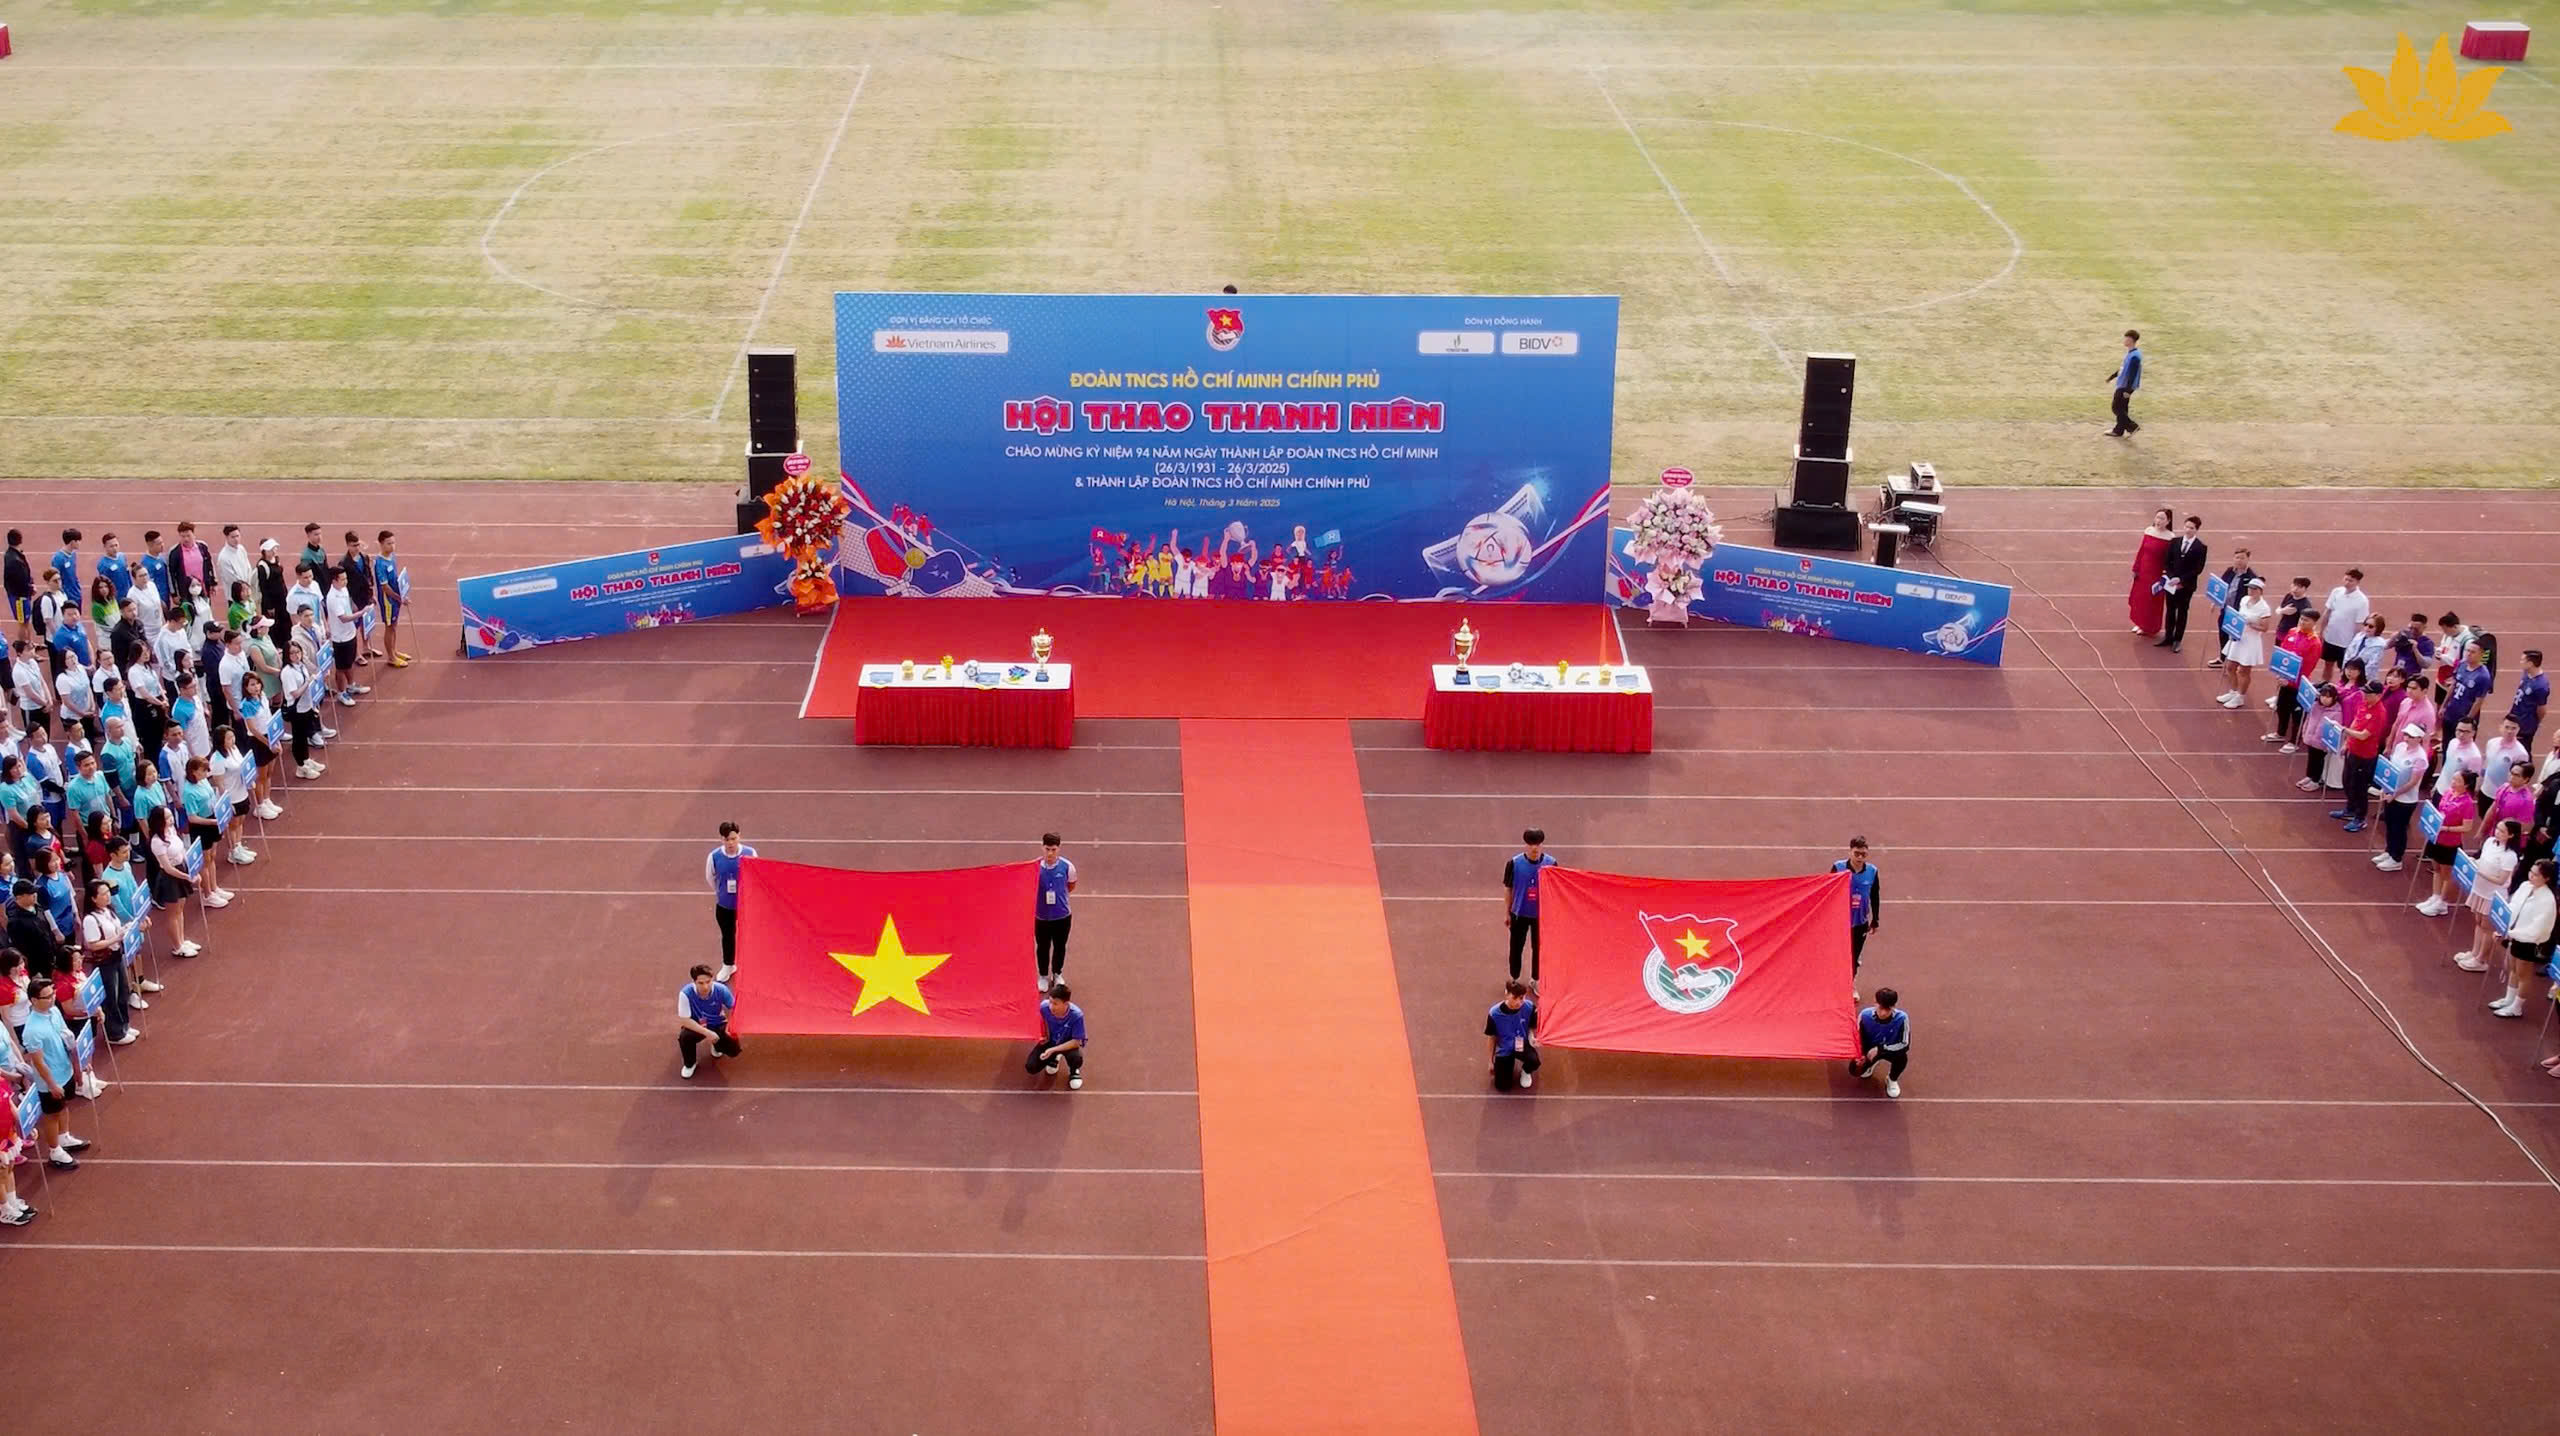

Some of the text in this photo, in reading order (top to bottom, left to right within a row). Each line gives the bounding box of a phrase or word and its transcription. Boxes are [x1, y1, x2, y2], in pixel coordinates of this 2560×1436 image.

[1519, 338, 1552, 350] BIDV
[1070, 367, 1380, 388] ĐOÀN TNCS HỒ CHÍ MINH CHÍNH PHỦ
[1004, 396, 1444, 435] HỘI THAO THANH NIÊN
[1005, 445, 1042, 458] CHÀO
[1044, 445, 1083, 458] MỪNG
[1103, 445, 1133, 460] NIỆM
[1136, 447, 1150, 458] 94
[1152, 445, 1182, 459] NĂM
[1184, 445, 1218, 459] NGÀY
[1221, 445, 1260, 459] THÀNH
[1263, 445, 1283, 461] LẬP
[1287, 445, 1323, 459] ĐOÀN
[1326, 447, 1357, 459] TNCS
[1360, 444, 1379, 459] HỒ
[1381, 445, 1403, 459] CHÍ
[1406, 447, 1438, 459] MINH
[1155, 462, 1216, 475] (26/3/1931
[1227, 462, 1290, 475] 26/3/2025)
[1075, 474, 1370, 490] & THÀNH LẬP ĐOÀN TNCS HỒ CHÍ MINH CHÍNH PHỦ
[1164, 498, 1177, 507] Hà
[1200, 498, 1226, 509] Tháng
[1227, 498, 1234, 507] 3
[1260, 498, 1281, 507] 2025
[570, 585, 599, 601] HỘI
[601, 578, 645, 595] THAO
[648, 568, 703, 588] THANH
[704, 562, 742, 578] NIÊN
[1714, 569, 1742, 585] HỘI
[1745, 573, 1791, 592] THAO
[1794, 581, 1851, 602] THANH
[1853, 590, 1894, 609] NIÊN
